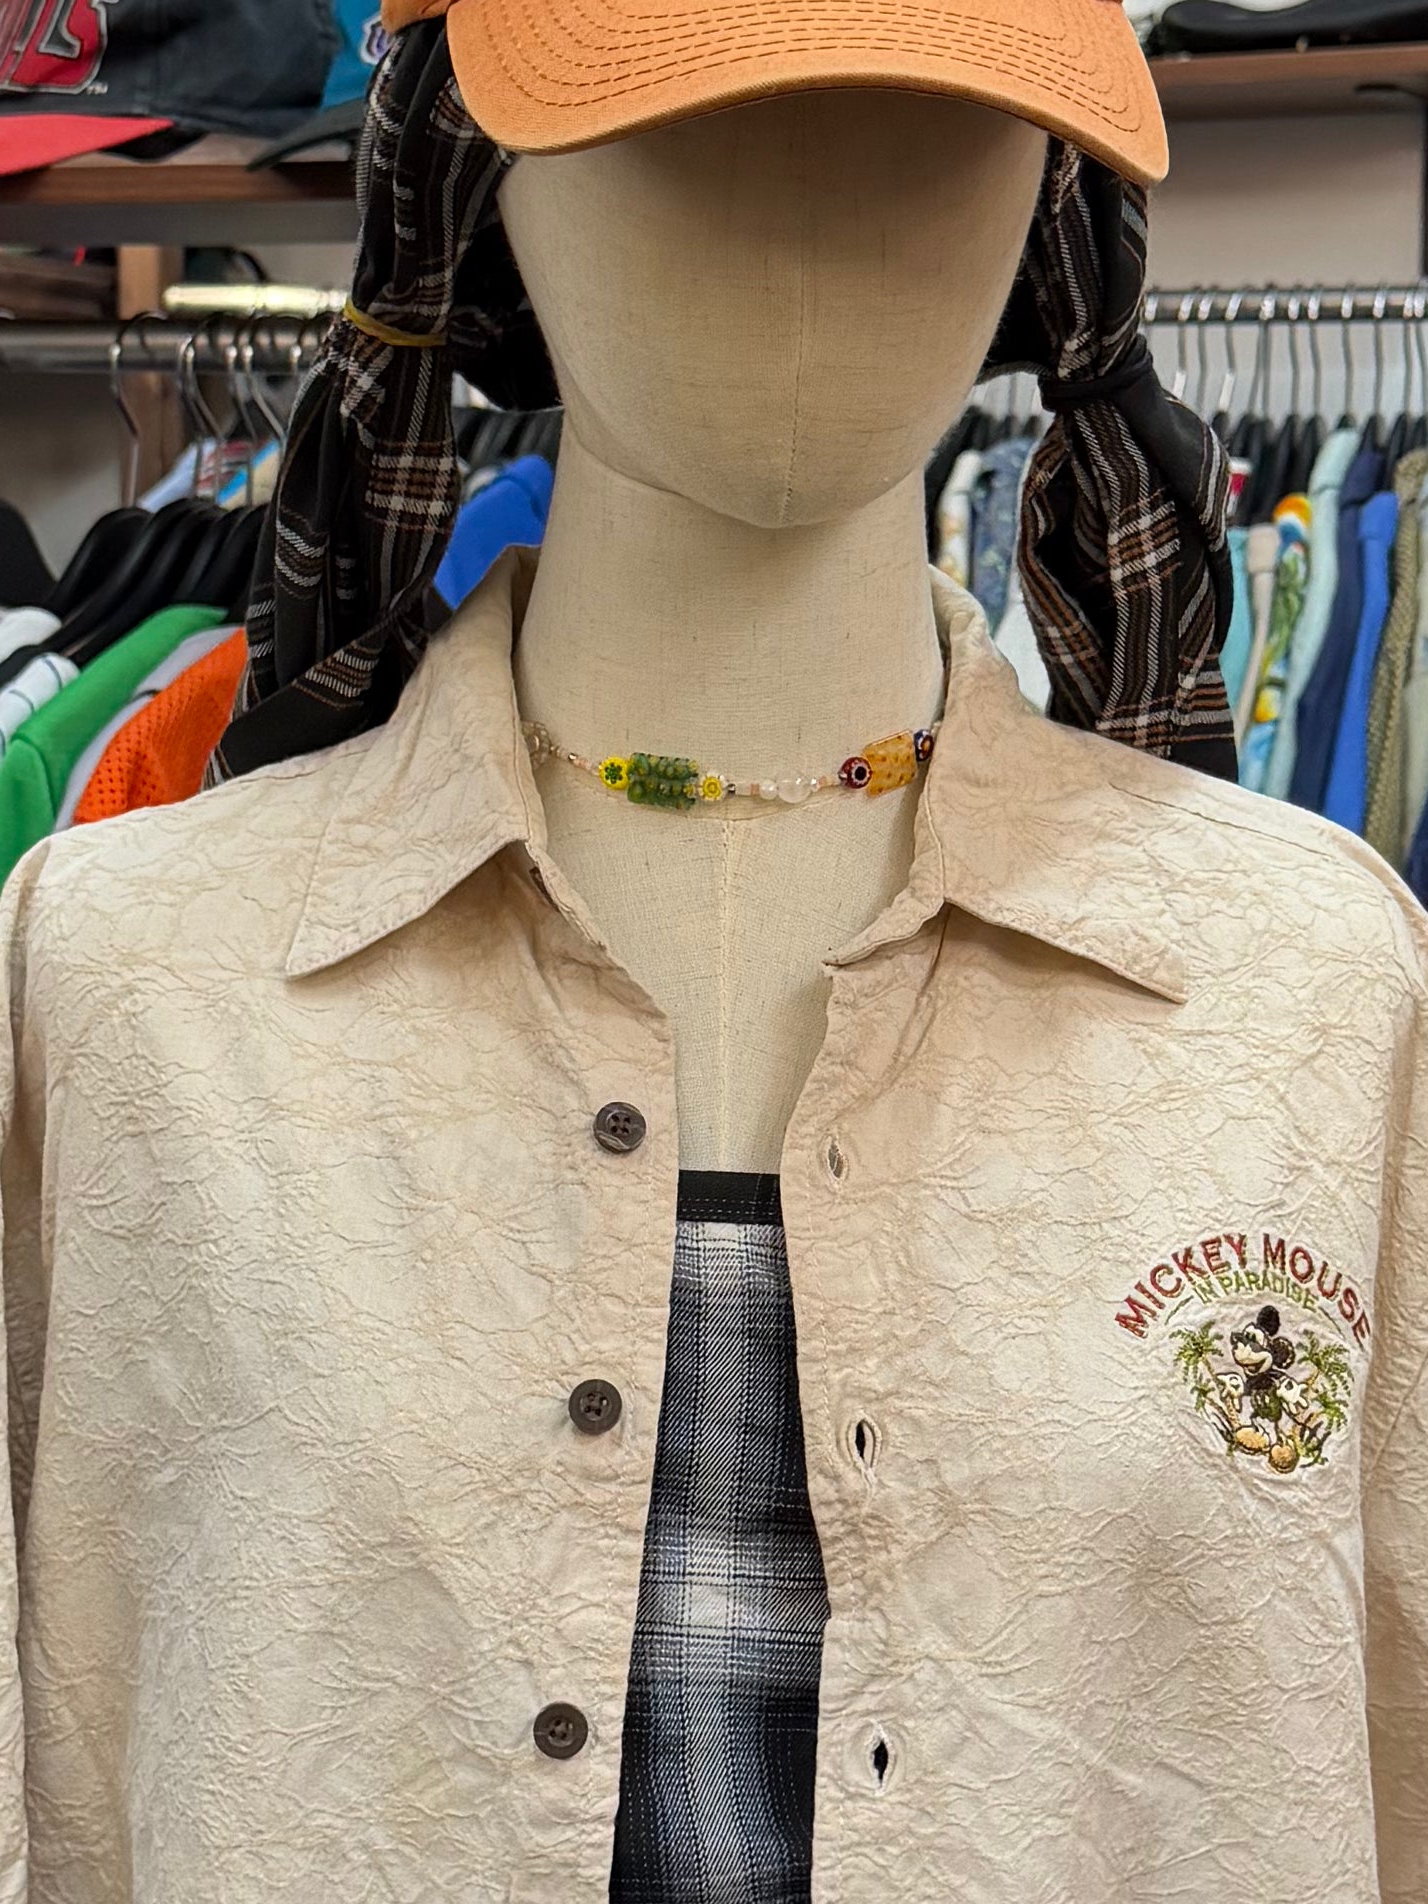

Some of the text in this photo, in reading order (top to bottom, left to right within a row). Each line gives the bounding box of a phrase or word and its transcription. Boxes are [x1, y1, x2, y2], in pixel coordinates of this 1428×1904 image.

[1114, 1232, 1372, 1350] MICKEY MOUSE
[1191, 1268, 1321, 1312] IN PARADISE
